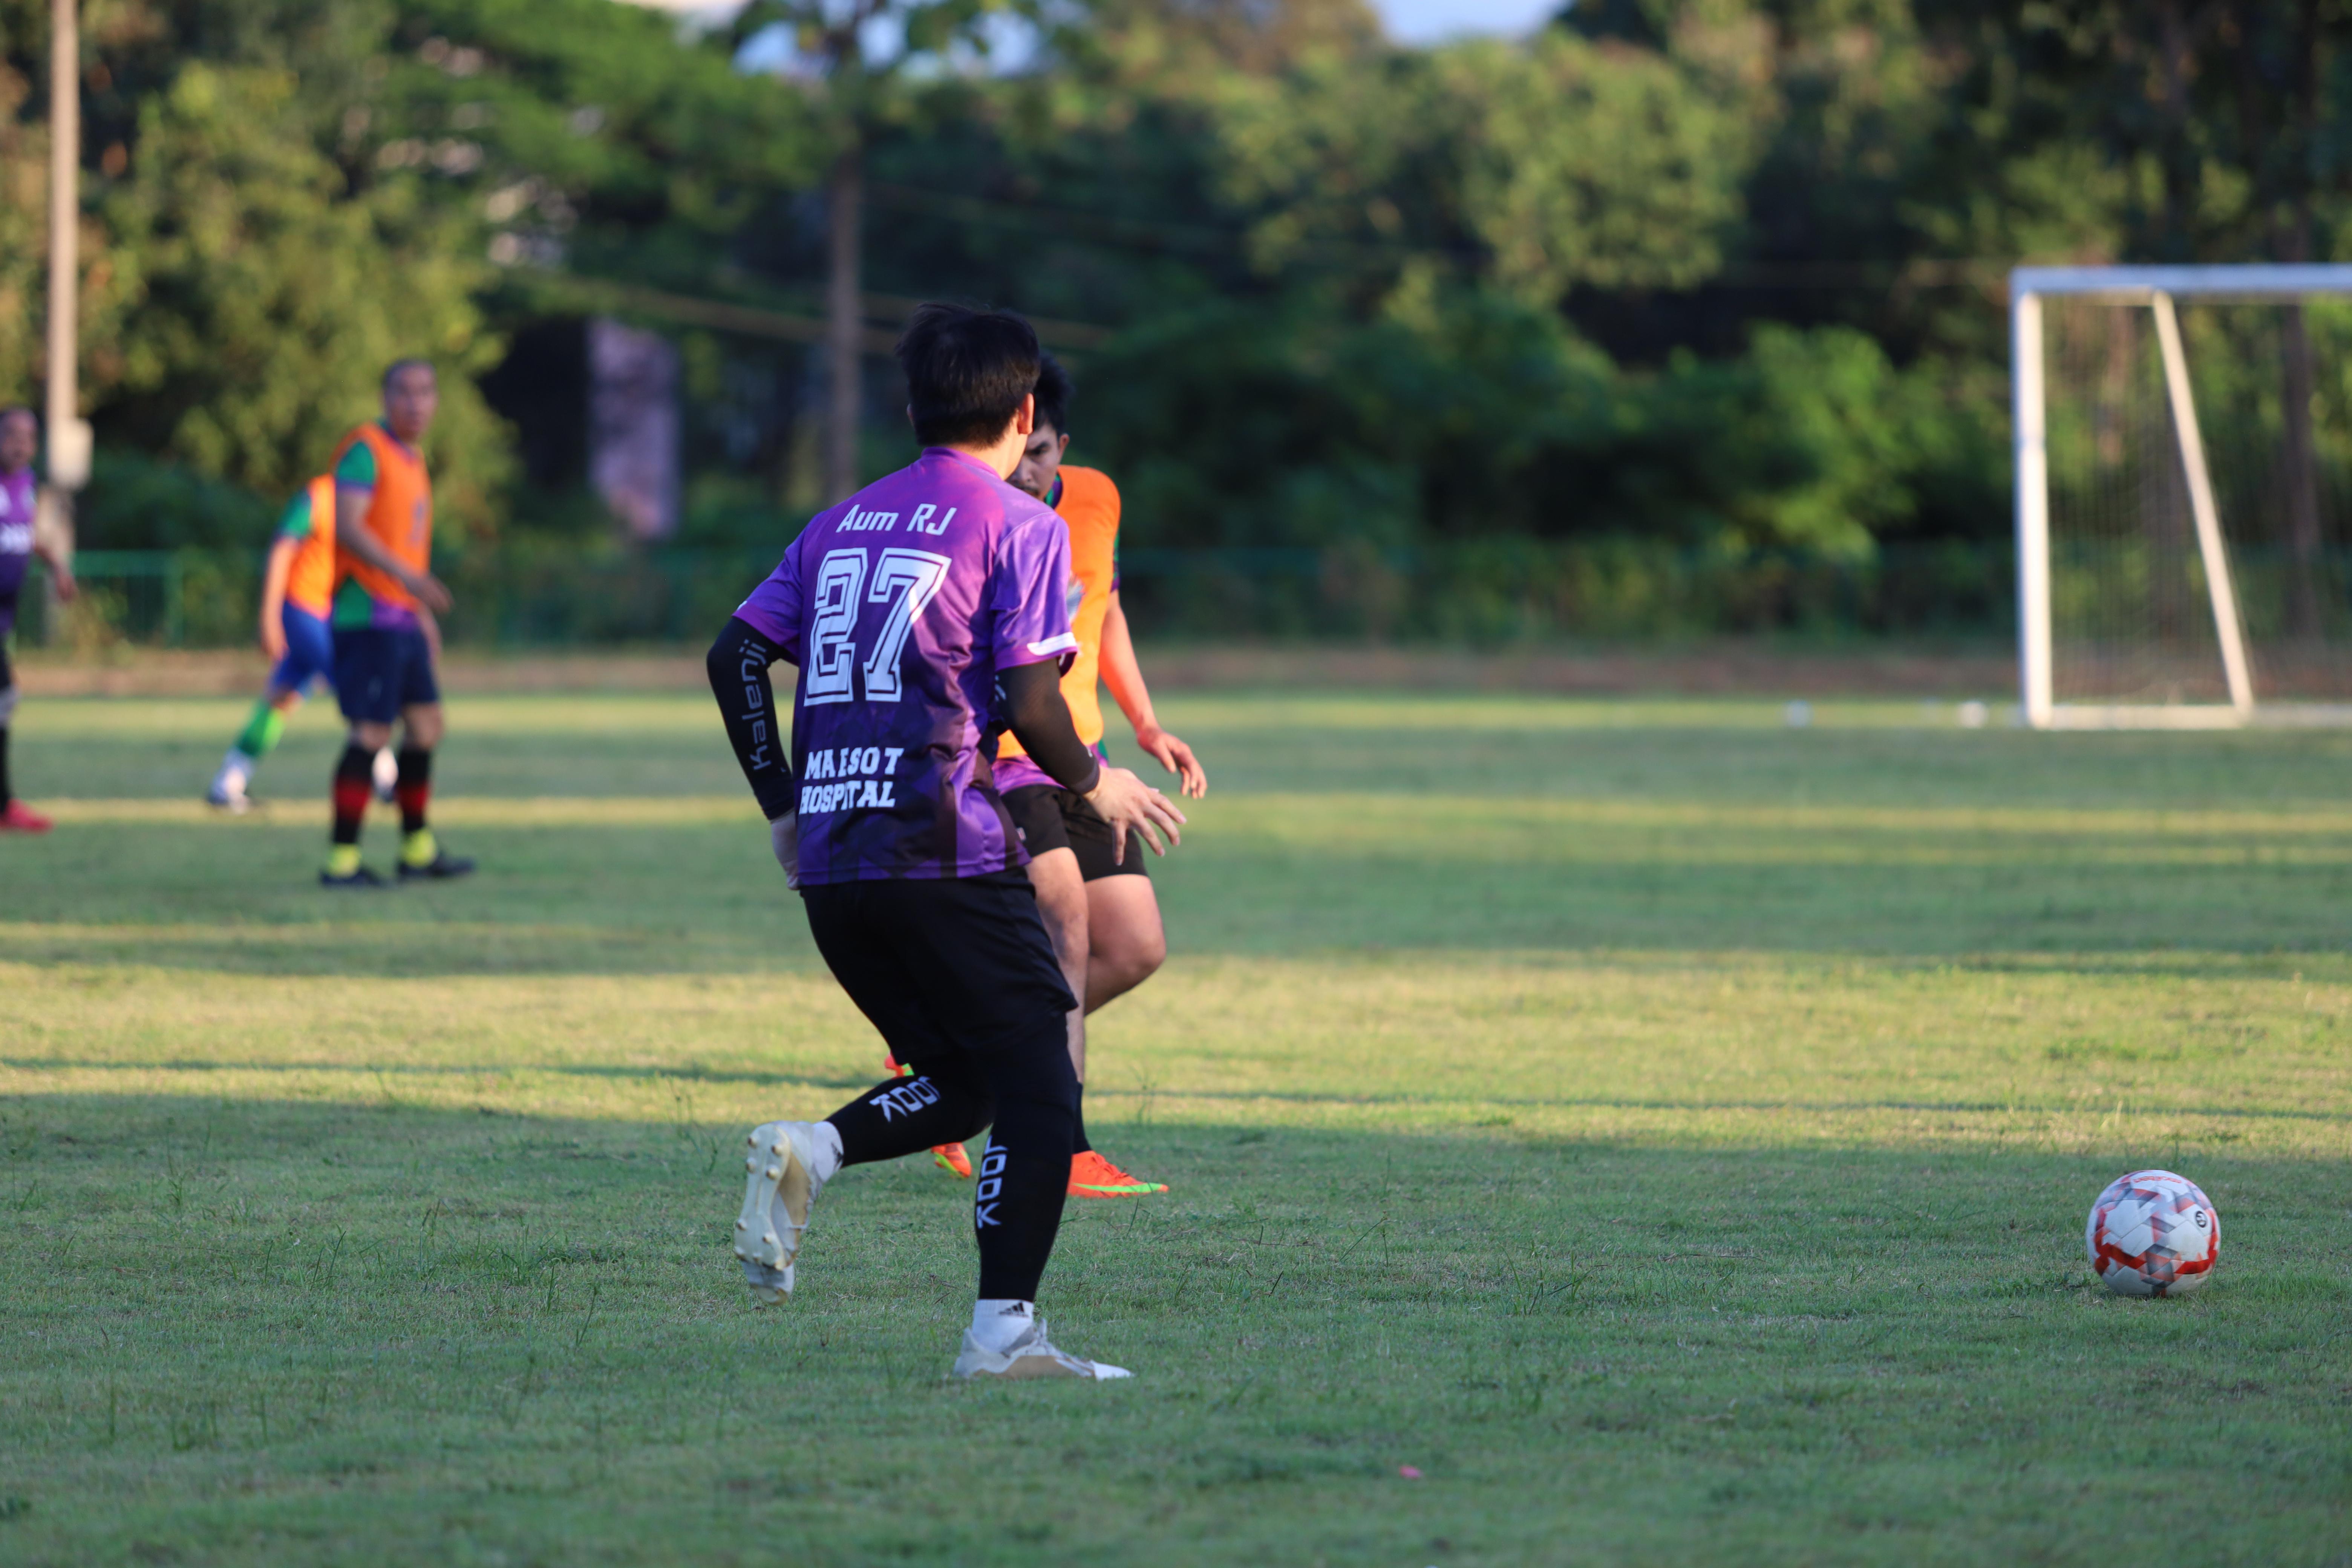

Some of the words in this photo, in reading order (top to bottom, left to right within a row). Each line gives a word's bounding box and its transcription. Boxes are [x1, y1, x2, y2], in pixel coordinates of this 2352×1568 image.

[836, 504, 899, 533] Aum
[906, 503, 957, 536] RJ
[804, 547, 951, 707] 27
[799, 779, 896, 815] HOSPITAL
